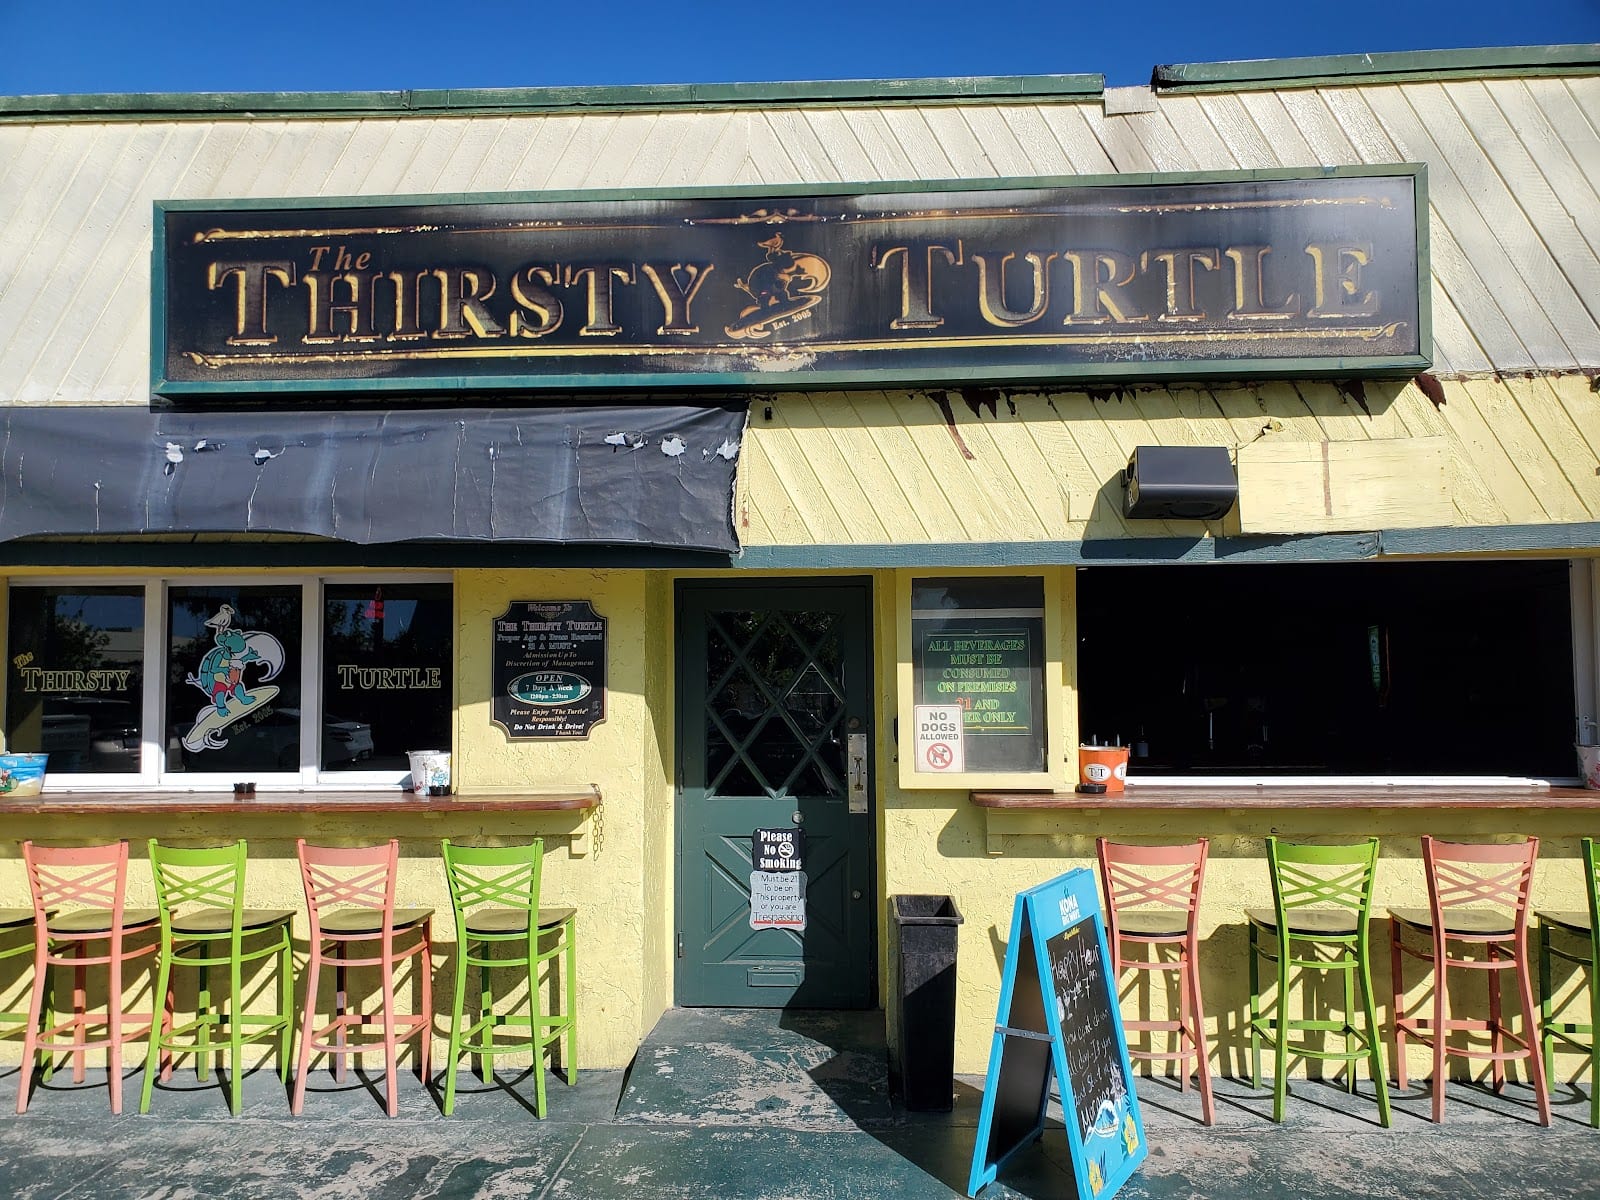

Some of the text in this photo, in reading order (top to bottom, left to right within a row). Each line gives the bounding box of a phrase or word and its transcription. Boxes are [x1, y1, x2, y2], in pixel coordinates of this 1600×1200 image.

[309, 244, 371, 271] The
[207, 239, 1379, 346] THIRSTY TURTLE
[791, 309, 812, 323] 2005
[497, 620, 602, 631] THE THIRSTY TURTLE
[928, 639, 1025, 651] ALL BEVERAGES
[13, 651, 34, 669] The
[950, 654, 1002, 665] MUST BE
[20, 667, 130, 691] THIRSTY
[338, 664, 441, 689] TURTLE
[943, 668, 1010, 679] CONSUMED
[937, 681, 1017, 693] ON PREMISES
[974, 699, 1000, 710] AND
[252, 705, 274, 723] 2005
[929, 712, 947, 720] NO
[983, 711, 1016, 723] ONLY
[921, 723, 956, 732] DOGS
[760, 831, 793, 842] Please
[764, 845, 776, 855] No
[759, 858, 802, 870] Smoking
[1058, 894, 1079, 916] KONA
[753, 911, 804, 923] Trespassing
[1049, 934, 1100, 984] Happy Hour
